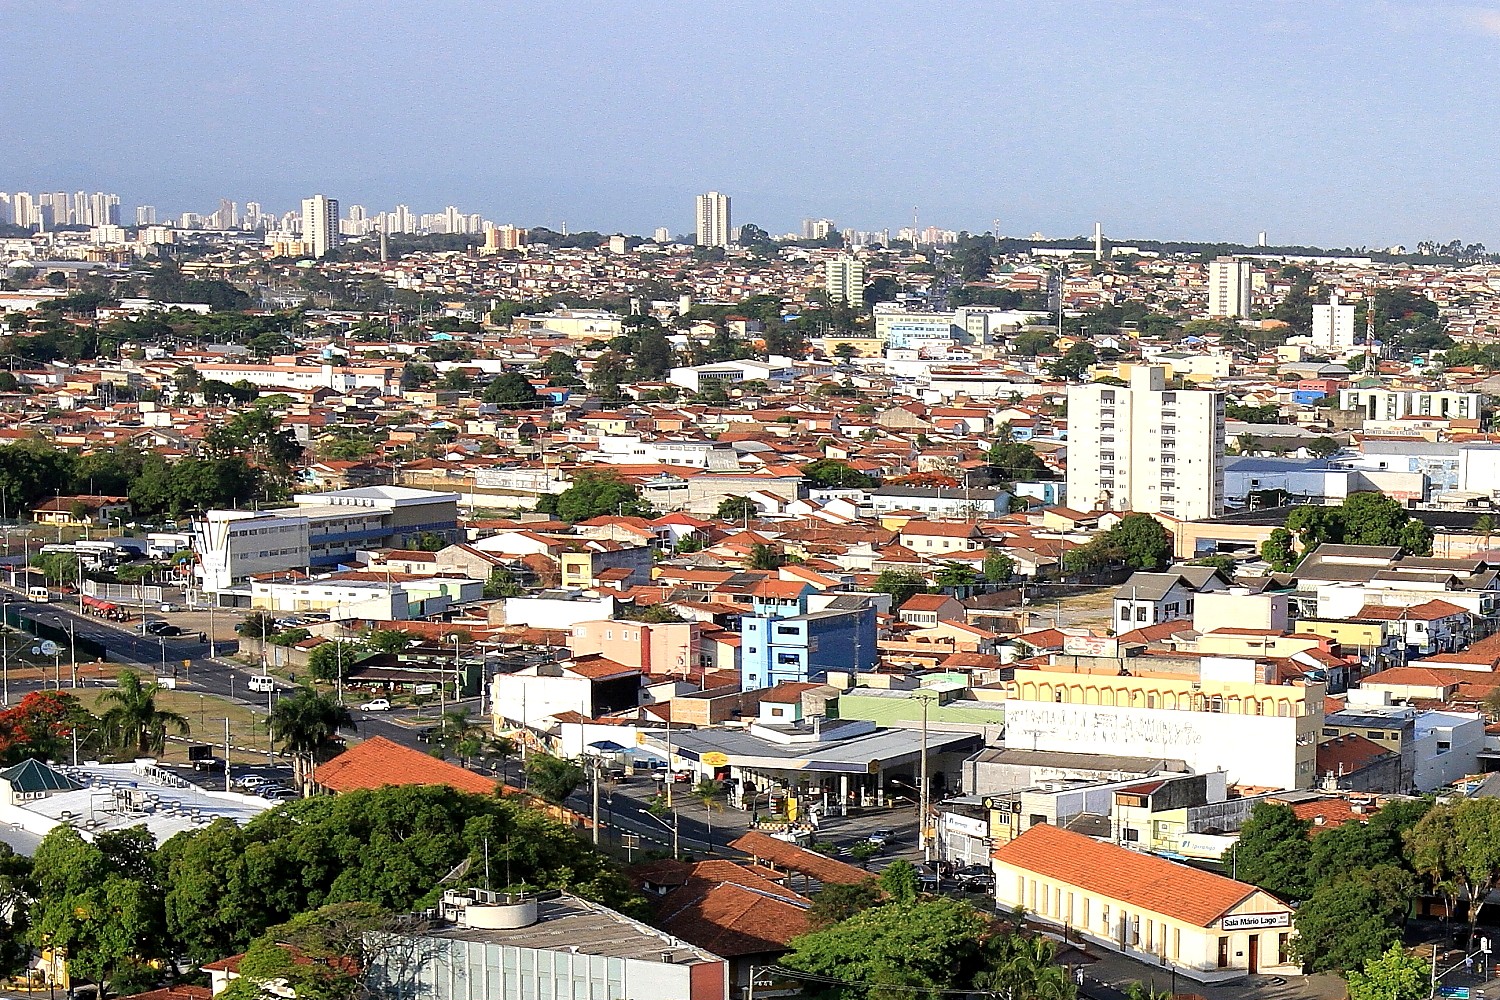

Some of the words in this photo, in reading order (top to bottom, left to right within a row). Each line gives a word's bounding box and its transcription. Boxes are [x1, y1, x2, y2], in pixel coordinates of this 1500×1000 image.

[1224, 919, 1239, 927] Sala
[1240, 917, 1260, 925] Mário
[1261, 917, 1277, 925] Lago
